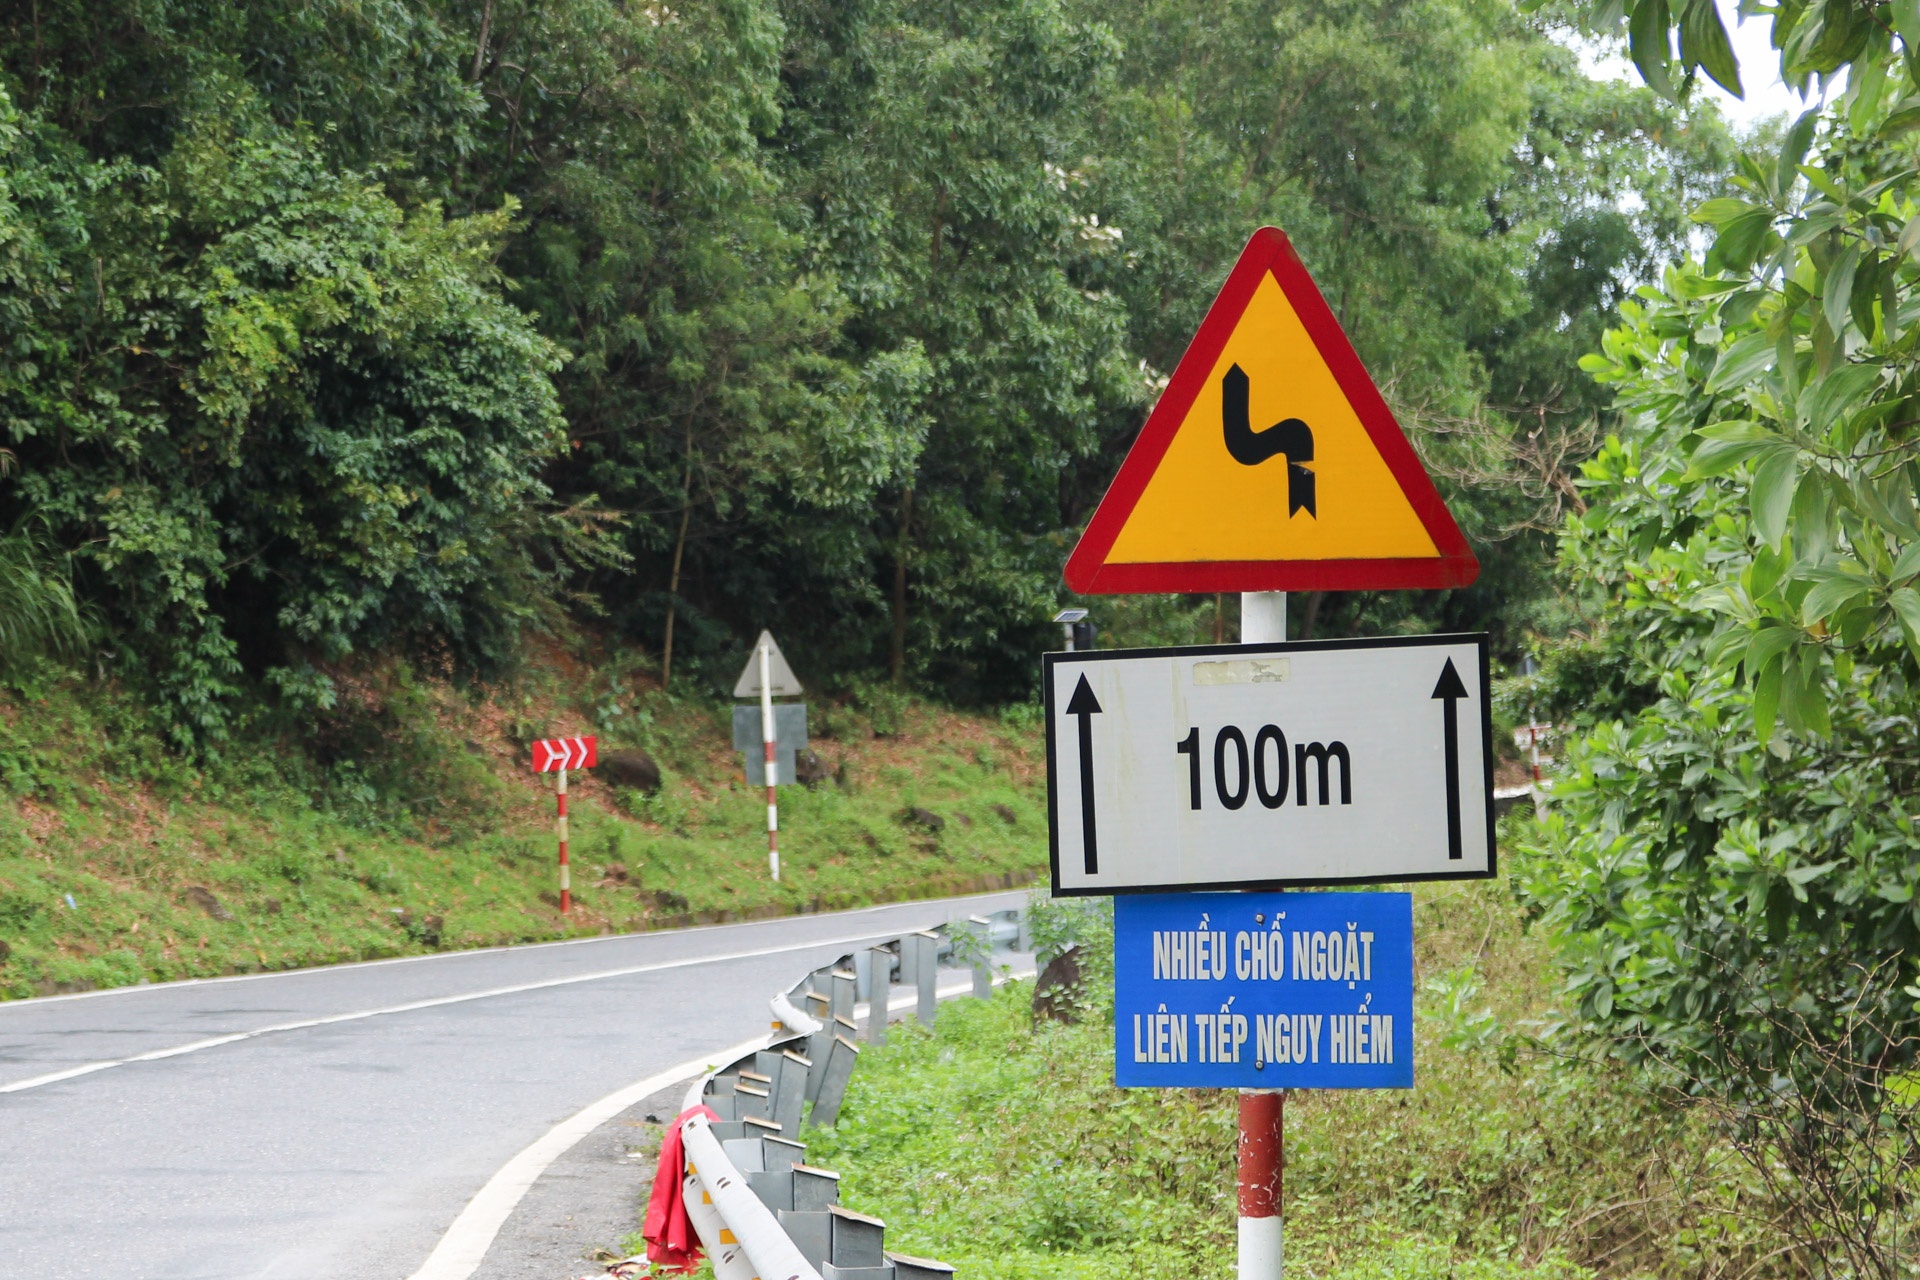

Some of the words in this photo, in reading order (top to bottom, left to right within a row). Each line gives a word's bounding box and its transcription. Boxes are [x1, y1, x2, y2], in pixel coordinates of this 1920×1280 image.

[1177, 724, 1352, 810] 100m
[1153, 913, 1227, 981] NHIỀU
[1235, 911, 1286, 981] CHỖ
[1292, 922, 1374, 989] NGOẶT
[1134, 1003, 1188, 1064] LIÊN
[1195, 996, 1249, 1064] TIẾP
[1256, 1014, 1321, 1064] NGUY
[1330, 993, 1393, 1064] HIỂM
